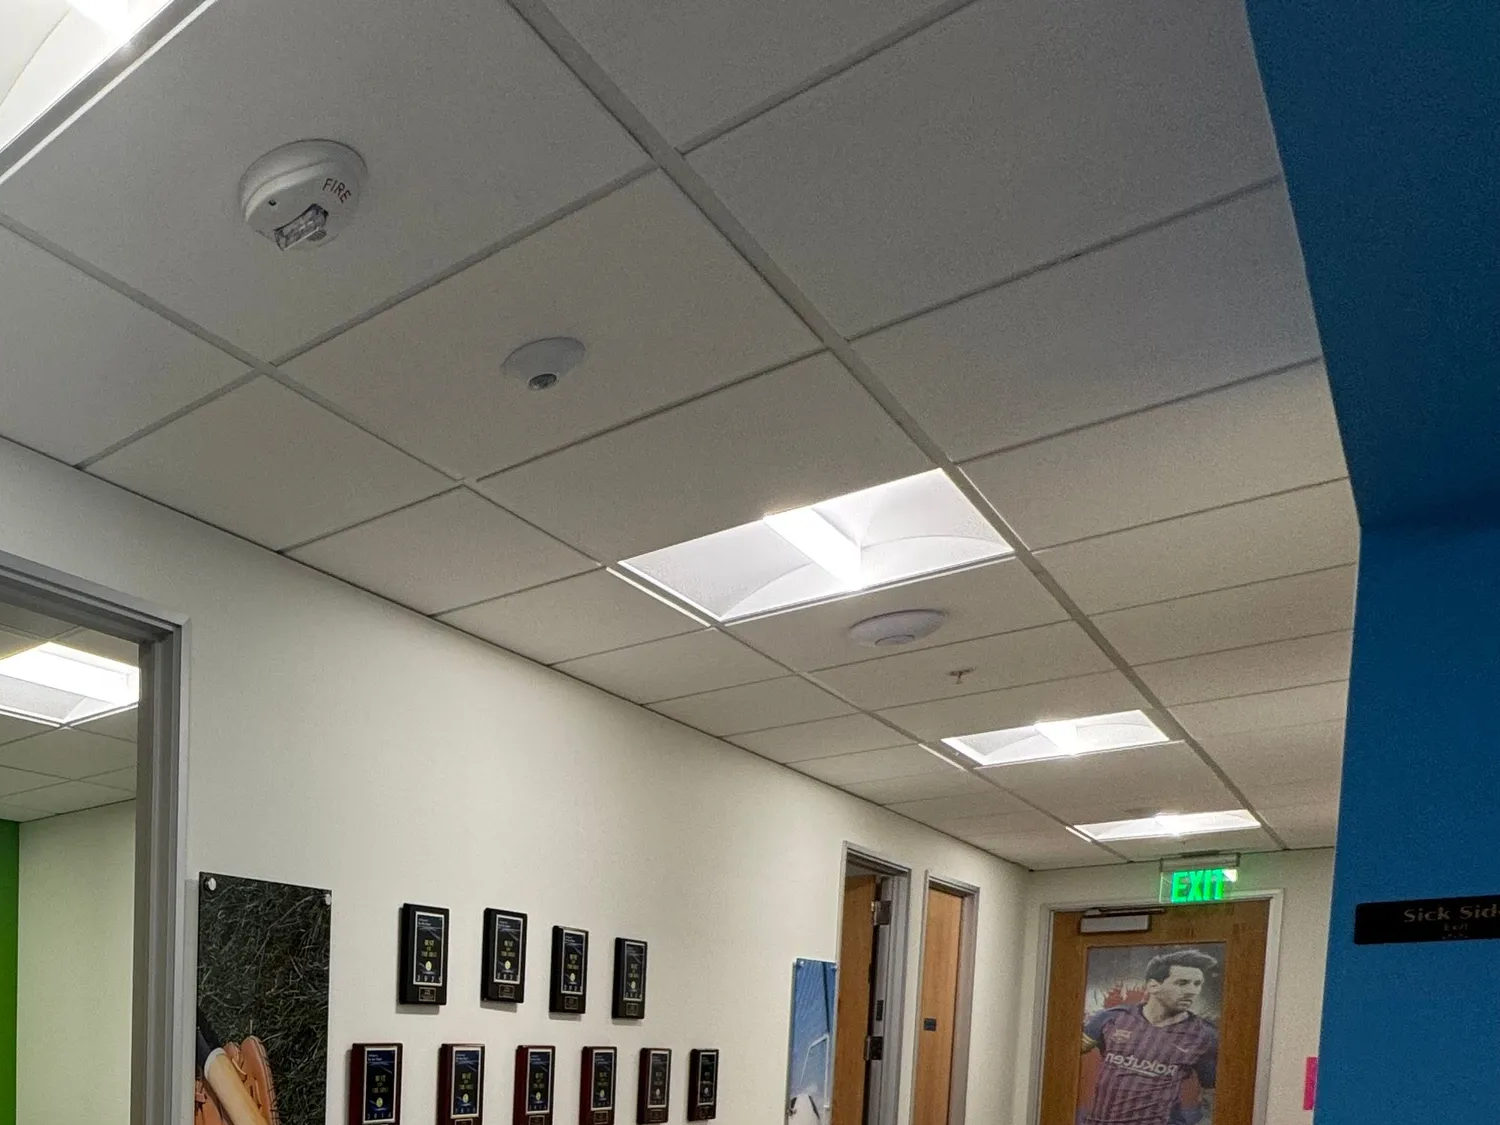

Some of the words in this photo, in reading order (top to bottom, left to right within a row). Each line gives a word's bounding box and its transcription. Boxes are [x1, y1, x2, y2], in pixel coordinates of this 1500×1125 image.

[322, 178, 352, 204] FIRE
[1171, 869, 1225, 903] EXIT
[1403, 905, 1452, 923] Sick
[1460, 903, 1500, 920] Sid
